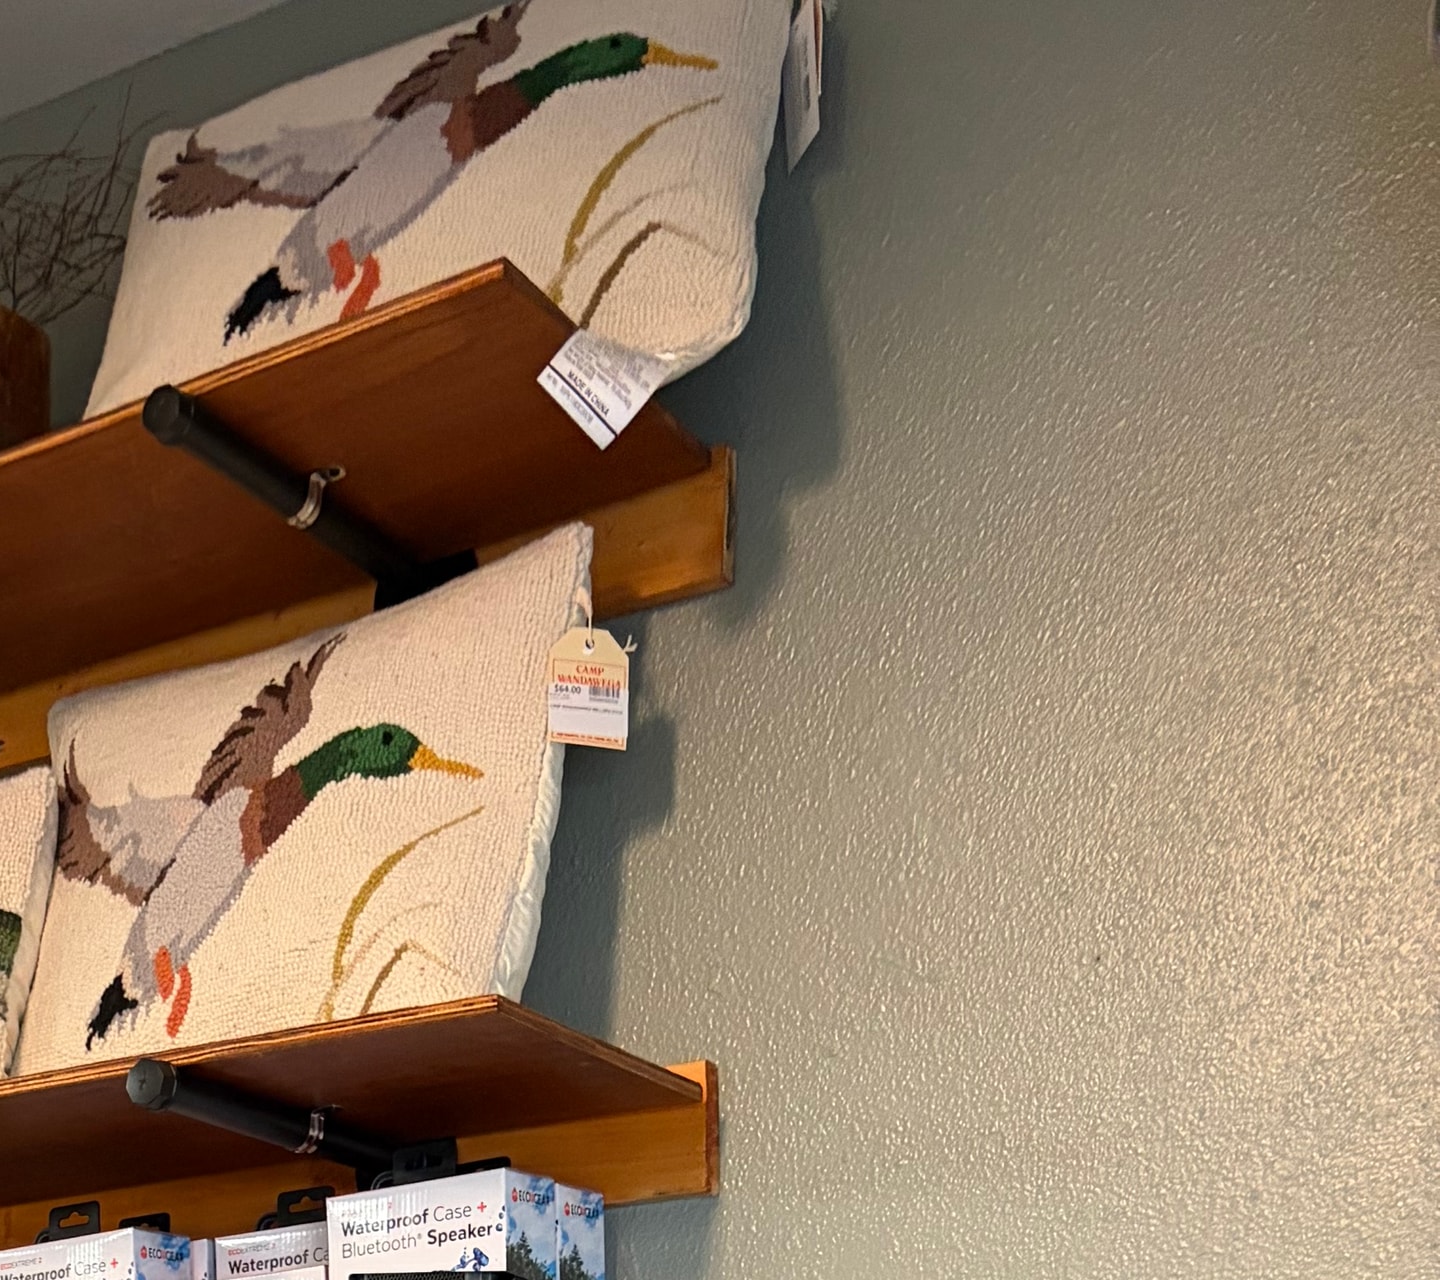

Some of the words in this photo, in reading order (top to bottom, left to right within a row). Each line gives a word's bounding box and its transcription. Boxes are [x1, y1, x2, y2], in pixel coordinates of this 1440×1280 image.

[567, 370, 586, 391] MADE
[591, 393, 610, 417] CHINA
[576, 665, 604, 677] CAMP
[341, 1208, 429, 1238] Waterproof
[433, 1205, 472, 1223] Case
[427, 1223, 493, 1248] Speaker
[74, 1258, 106, 1276] Case
[229, 1249, 309, 1275] Waterproof
